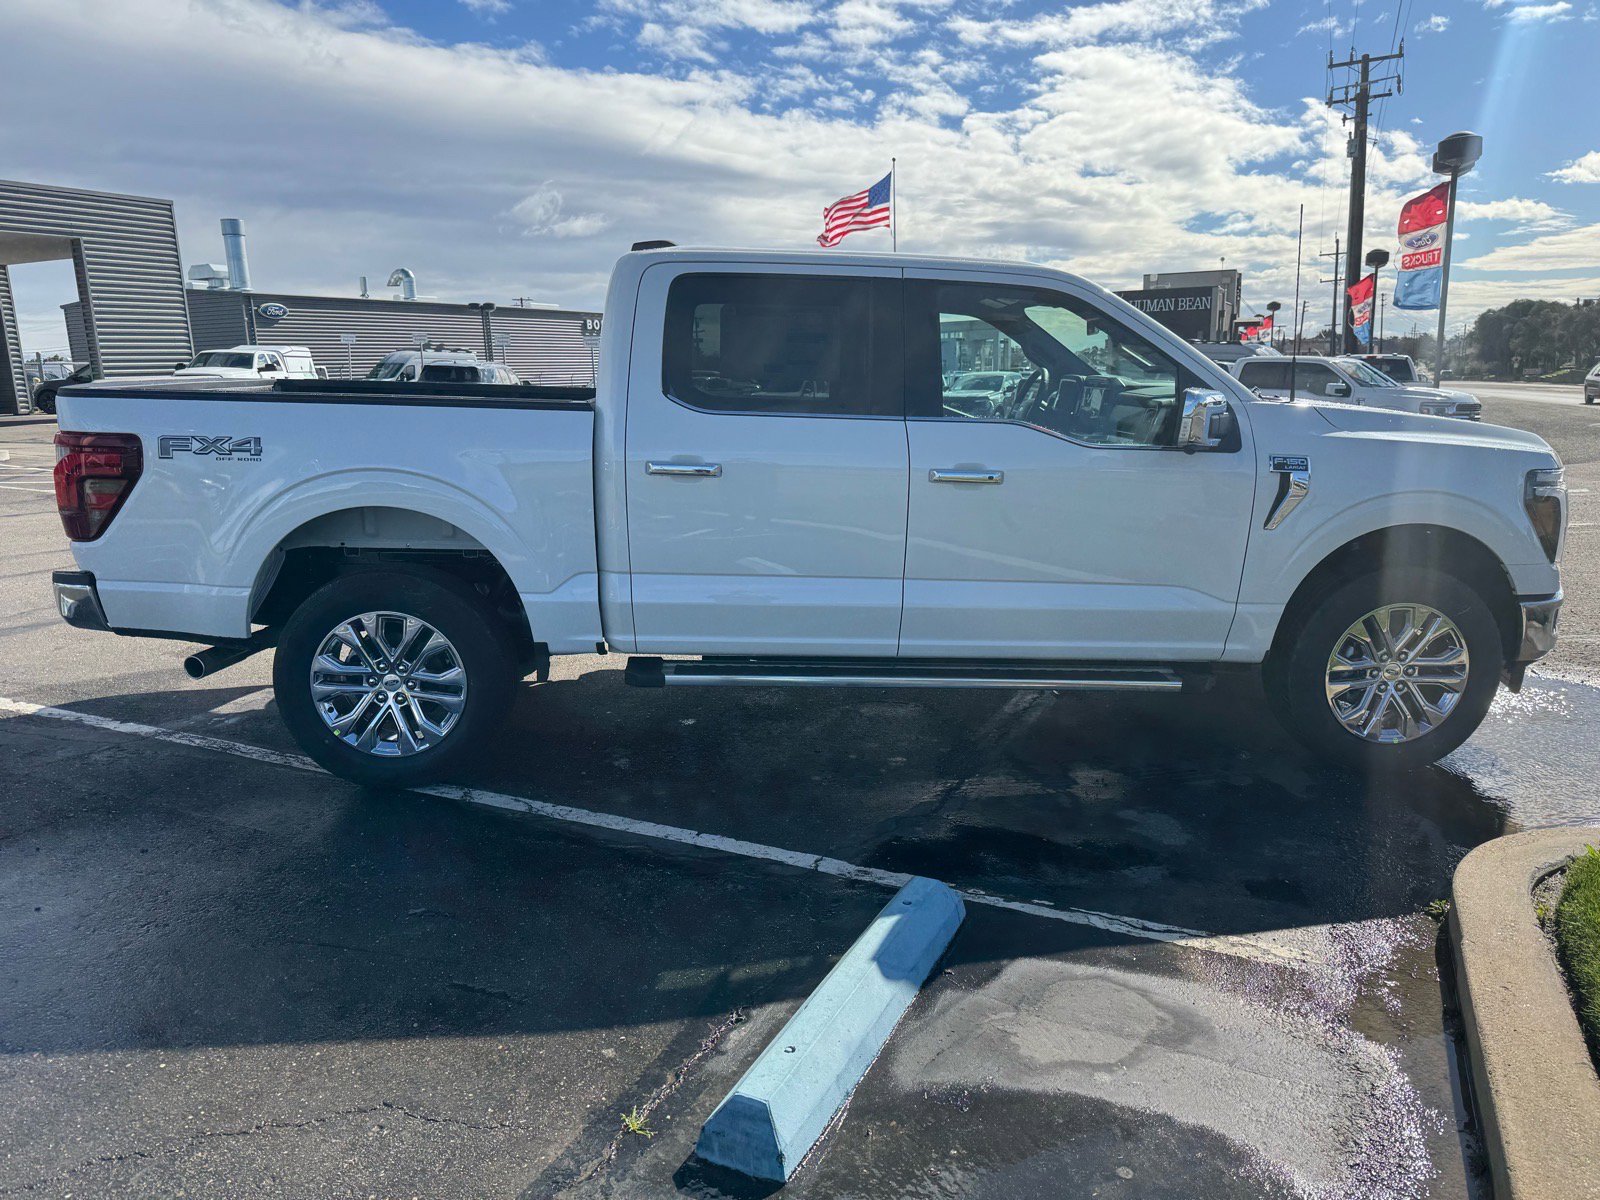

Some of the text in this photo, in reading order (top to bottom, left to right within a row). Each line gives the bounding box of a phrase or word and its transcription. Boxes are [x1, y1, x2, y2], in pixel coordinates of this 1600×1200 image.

[1177, 296, 1212, 311] BEAN
[158, 435, 262, 459] FX4
[1274, 457, 1307, 465] F-150
